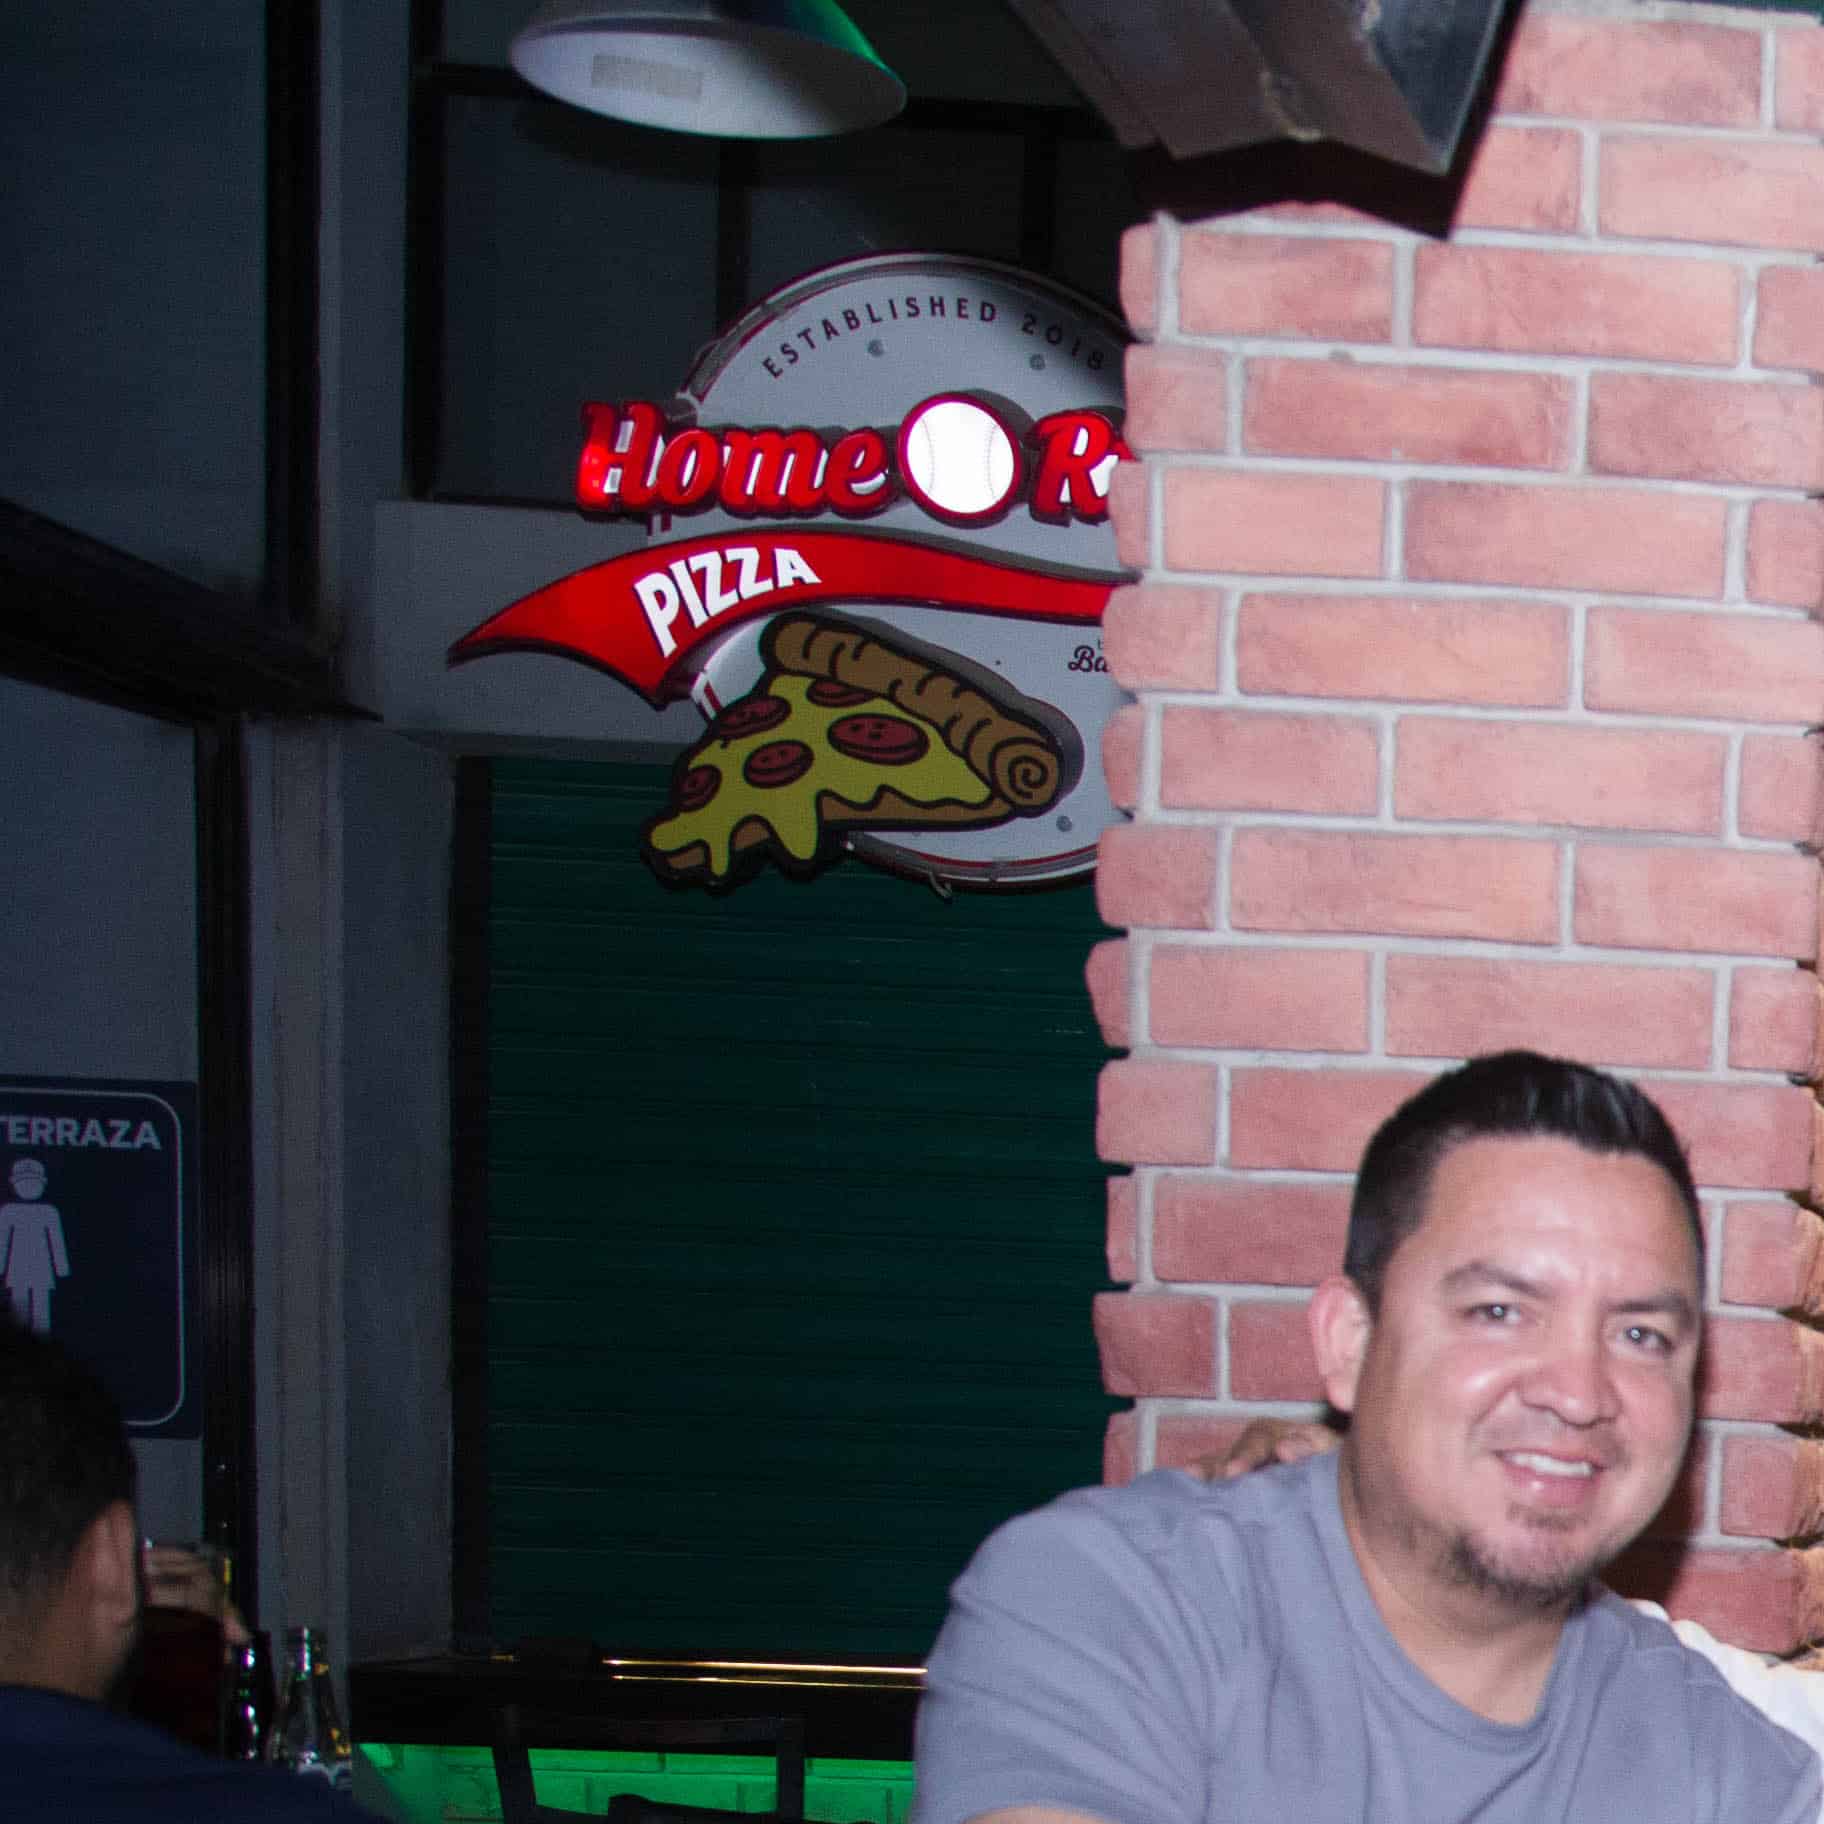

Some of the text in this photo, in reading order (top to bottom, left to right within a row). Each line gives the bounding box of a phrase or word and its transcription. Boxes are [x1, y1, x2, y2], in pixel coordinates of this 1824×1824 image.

[762, 295, 998, 379] ESTABLISHED
[576, 401, 890, 516] Home
[633, 547, 822, 658] PIZZA
[0, 1116, 162, 1150] ERRAZA
